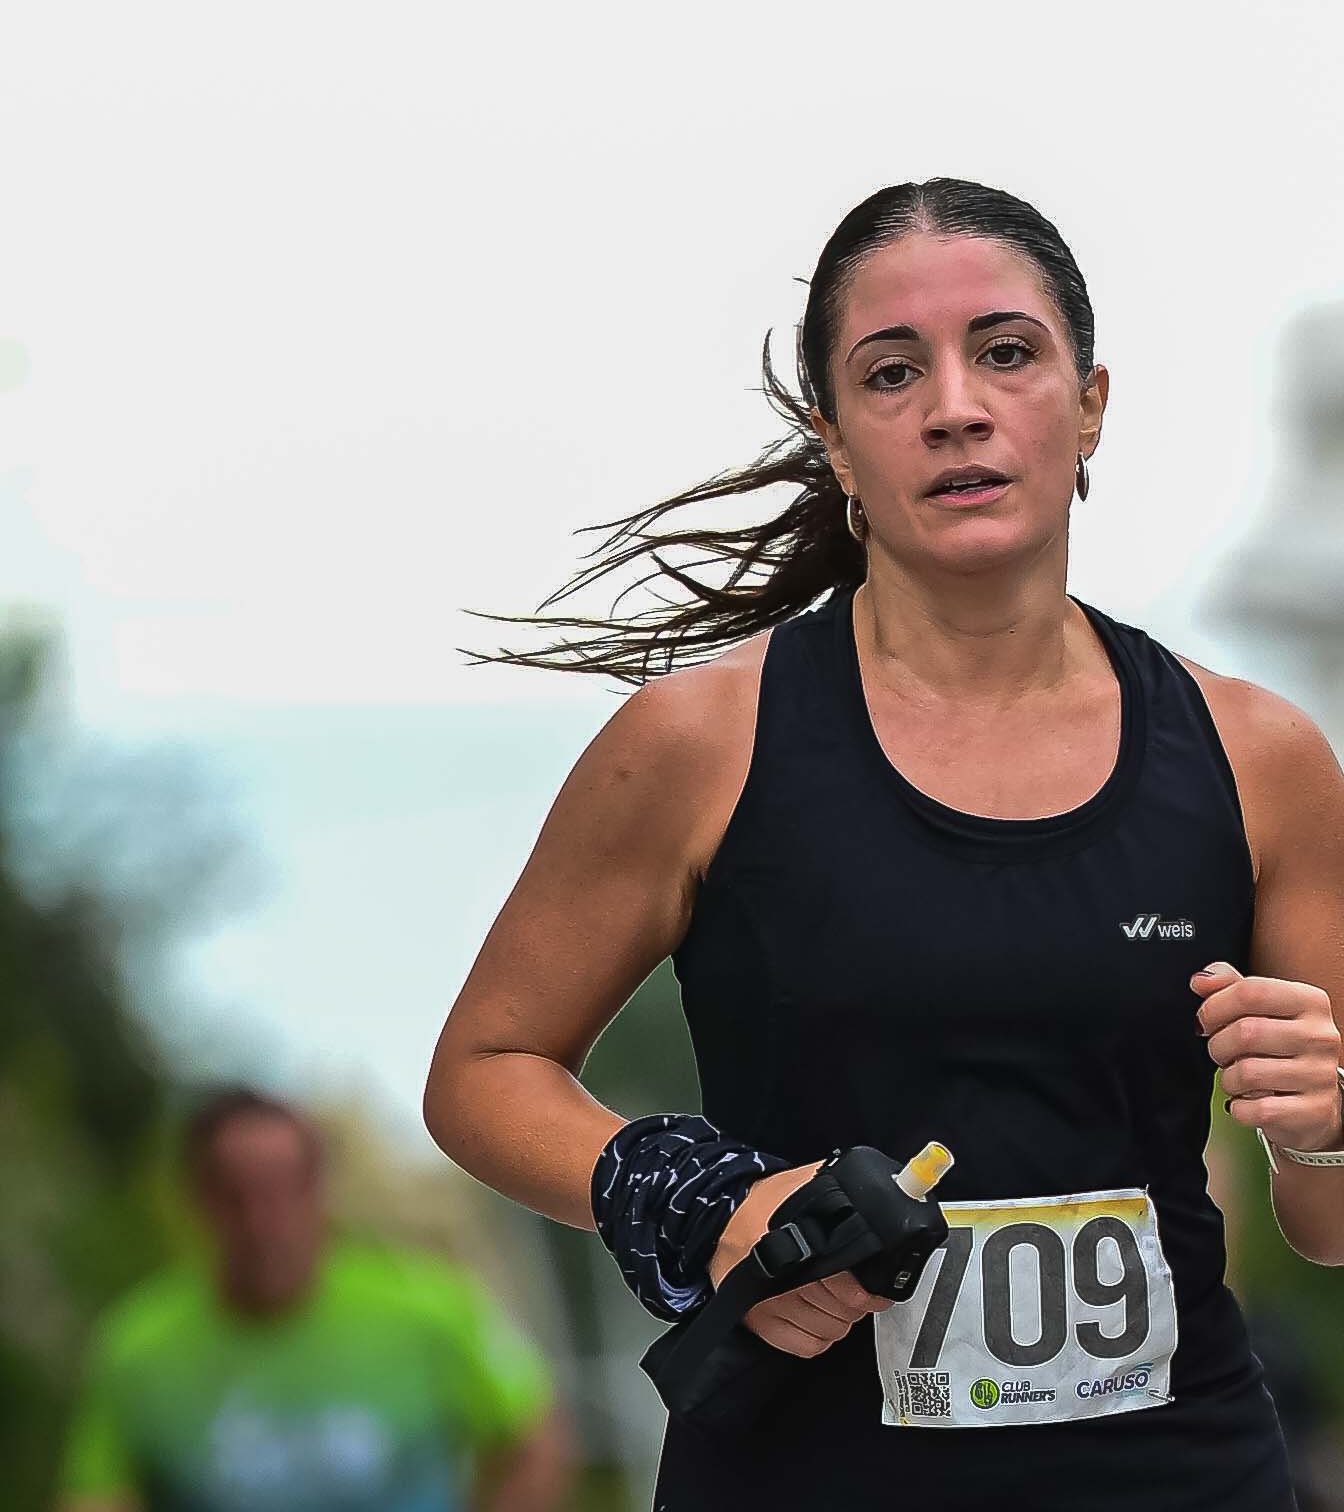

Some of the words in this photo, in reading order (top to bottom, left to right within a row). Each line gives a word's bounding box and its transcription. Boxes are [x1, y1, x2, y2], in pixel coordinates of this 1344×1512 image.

[1157, 921, 1194, 938] weis
[907, 1215, 1151, 1369] 709
[1001, 1380, 1031, 1393] CLUB
[1076, 1371, 1149, 1399] CARUSO
